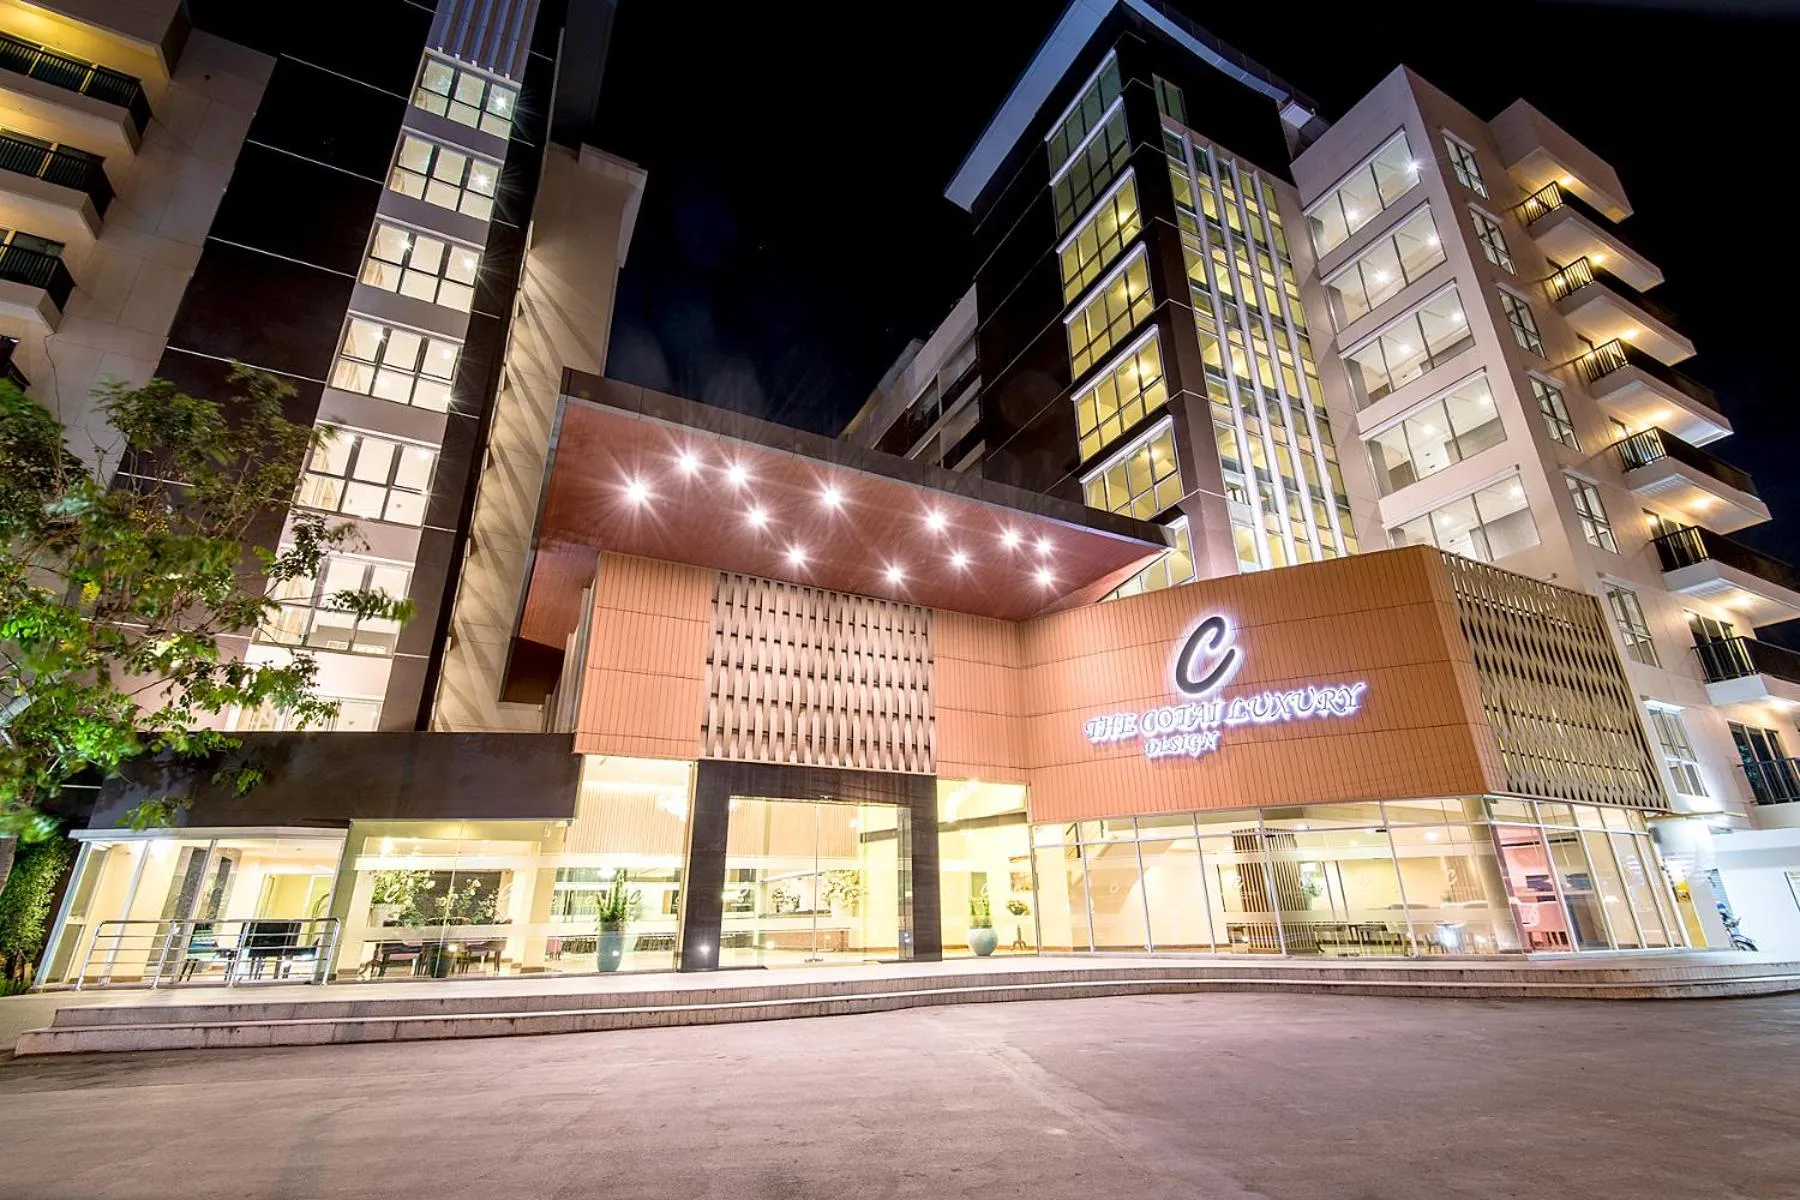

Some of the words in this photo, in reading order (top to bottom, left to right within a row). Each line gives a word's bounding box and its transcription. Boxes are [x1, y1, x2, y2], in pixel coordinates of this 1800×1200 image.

[1085, 715, 1135, 739] THE
[1140, 701, 1221, 733] COTAI
[1227, 684, 1366, 720] LUXURY
[1145, 732, 1218, 754] DESIGN
